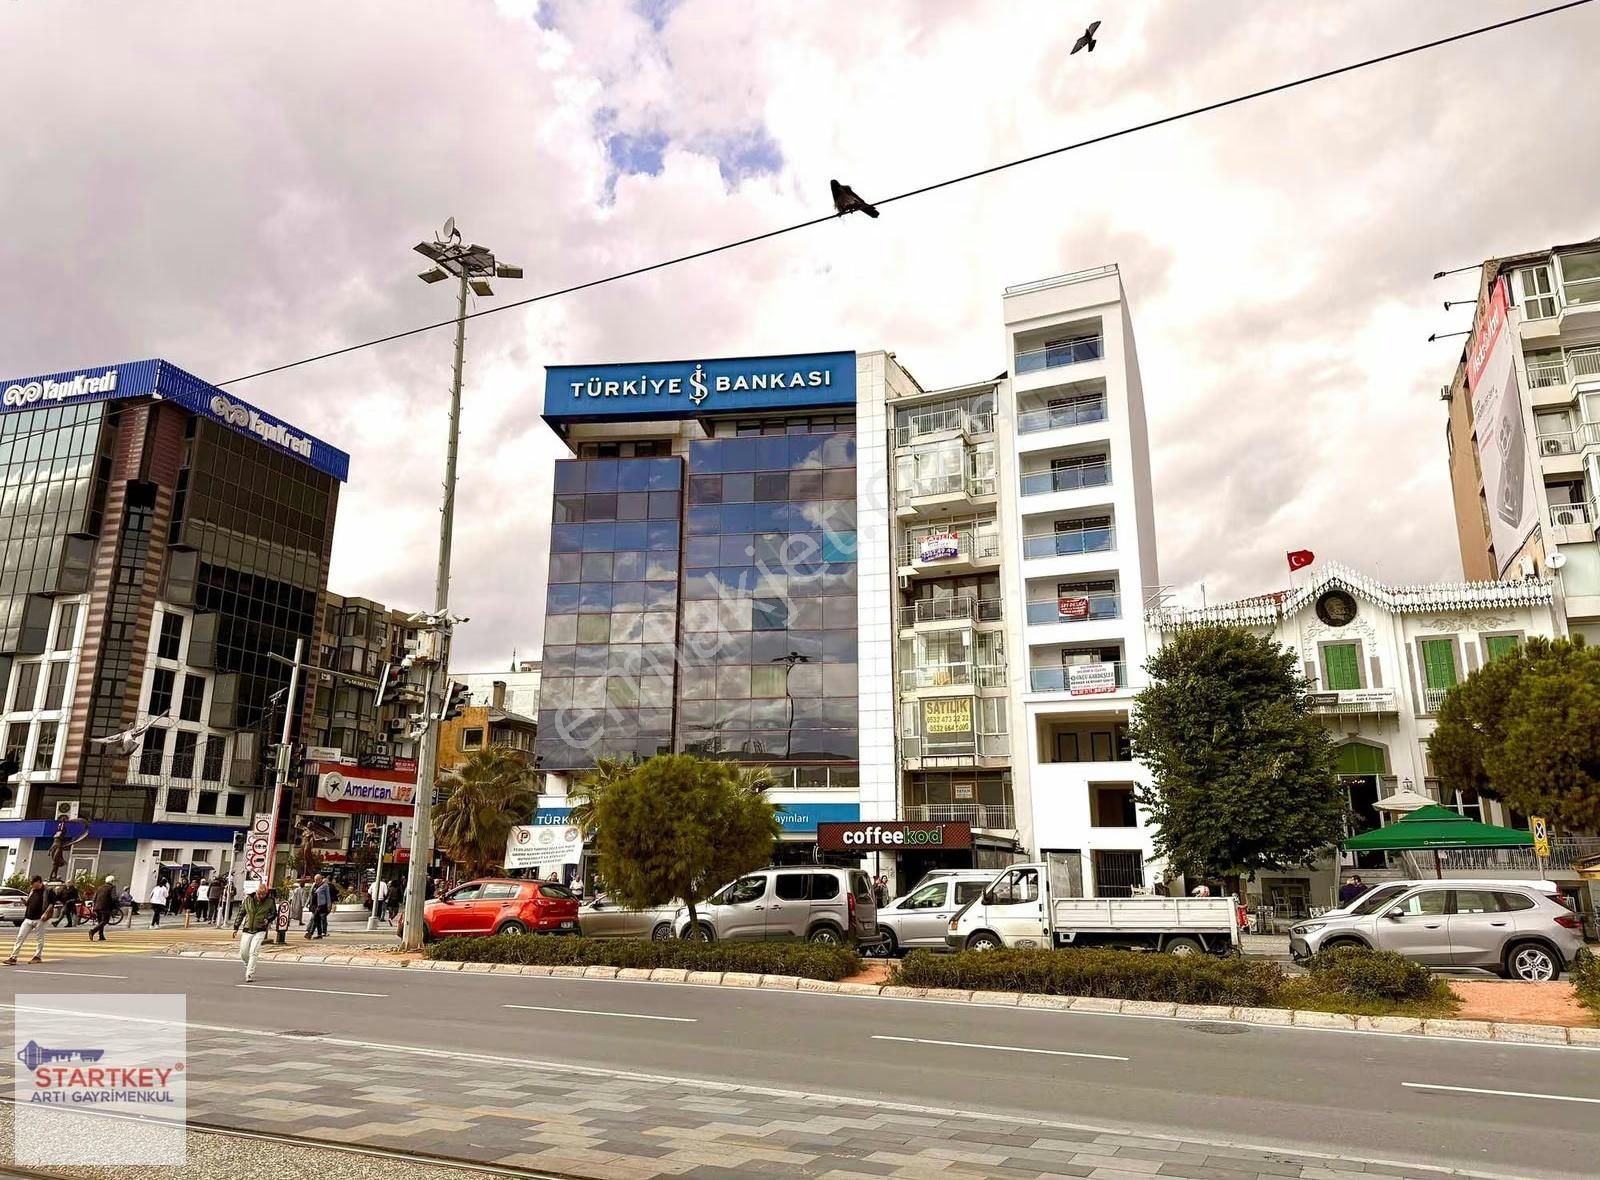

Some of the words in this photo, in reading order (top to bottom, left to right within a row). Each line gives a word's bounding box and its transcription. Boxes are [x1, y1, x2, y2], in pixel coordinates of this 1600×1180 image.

[570, 375, 682, 397] TÜRKİYE
[715, 370, 831, 392] BANKASI
[926, 700, 968, 715] SATILIK
[843, 826, 943, 844] coffeekod
